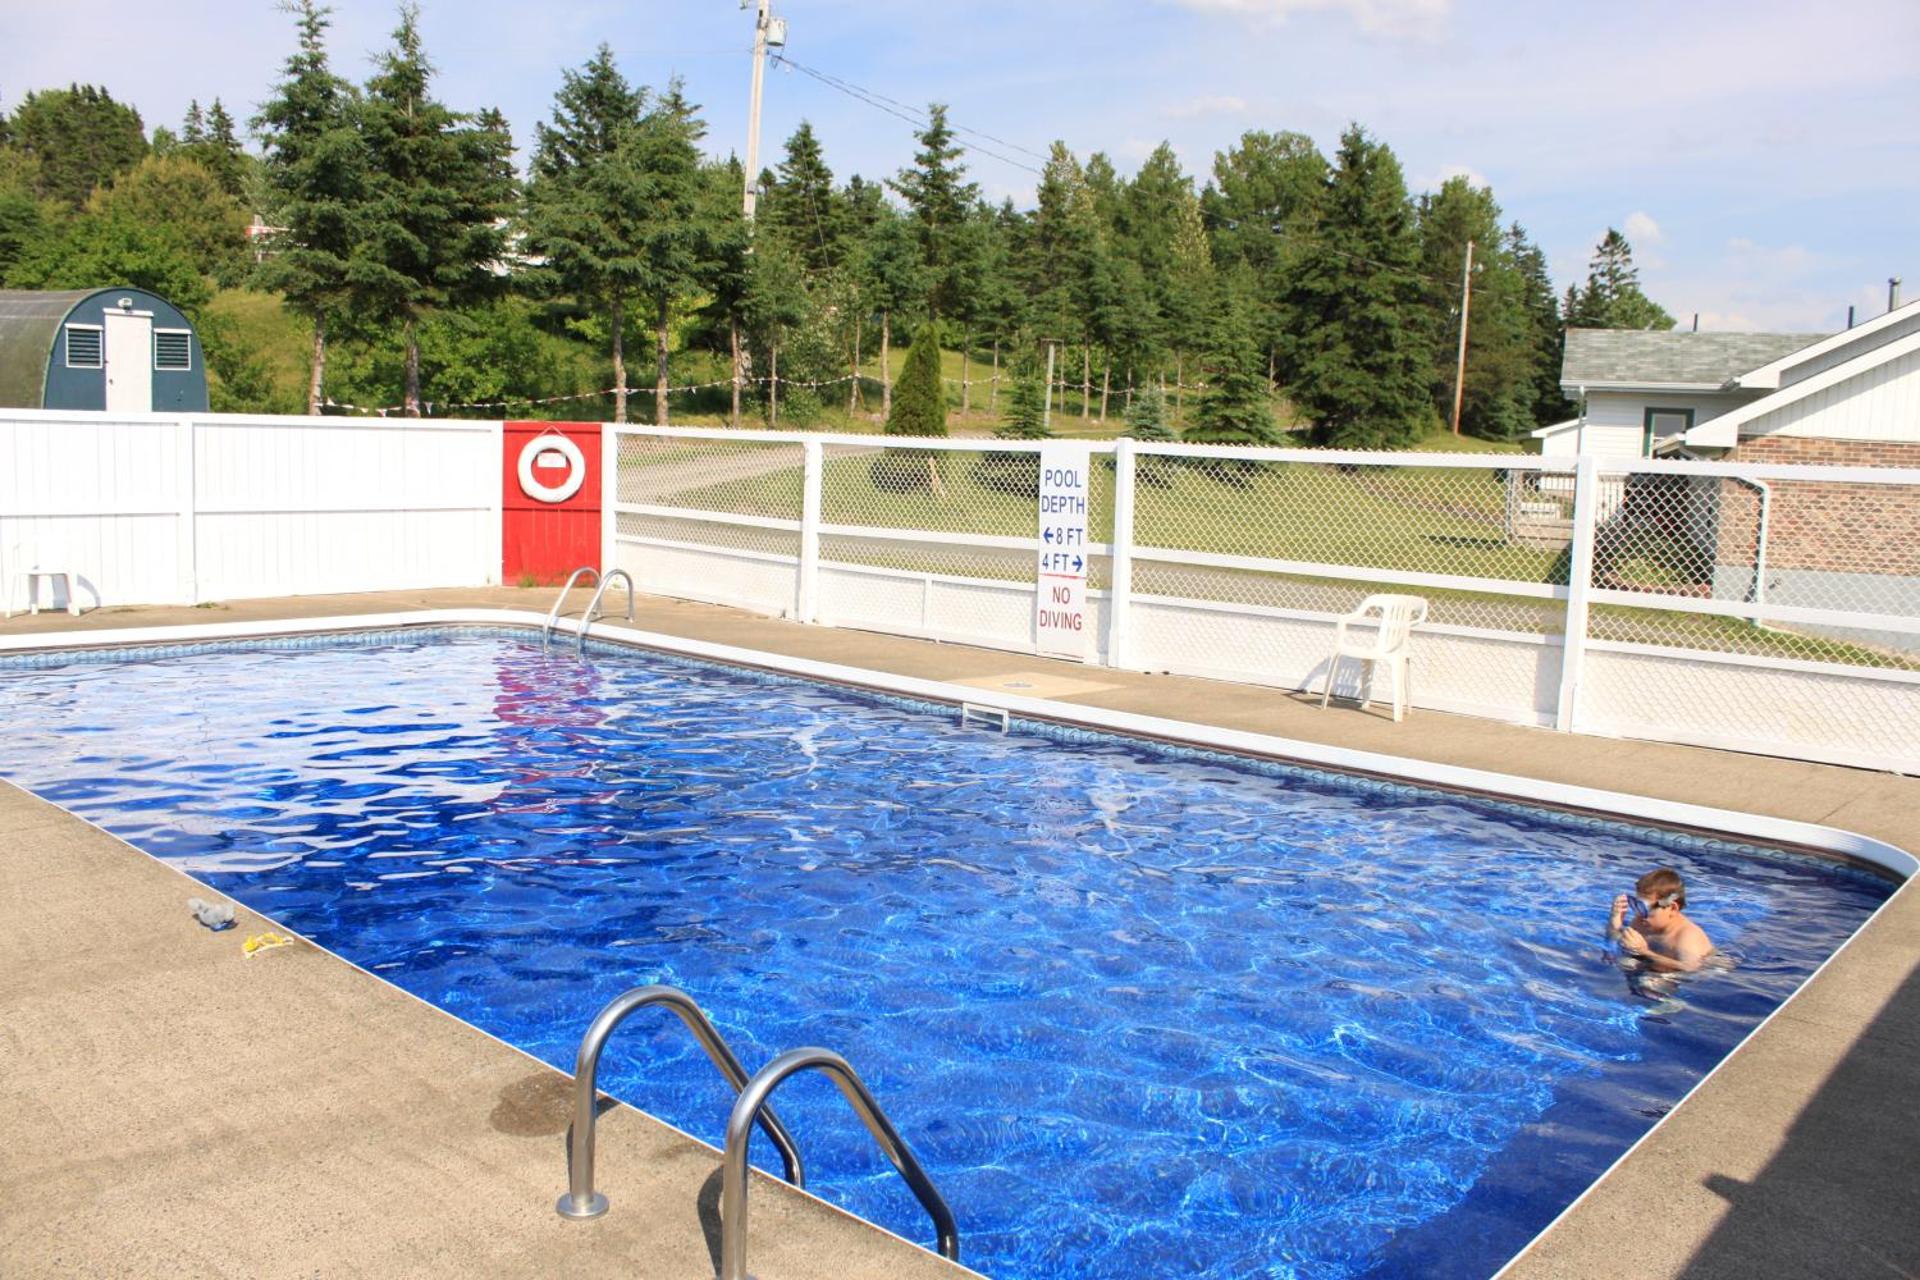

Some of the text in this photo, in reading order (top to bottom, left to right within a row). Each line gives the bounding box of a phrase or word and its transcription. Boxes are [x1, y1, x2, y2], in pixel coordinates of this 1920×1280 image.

[1045, 469, 1082, 488] POOL
[1041, 495, 1085, 514] DEPTH
[1056, 527, 1083, 546] 8 FT
[1042, 553, 1069, 571] 4 FT
[1052, 586, 1071, 604] NO
[1039, 609, 1082, 631] DIVING
